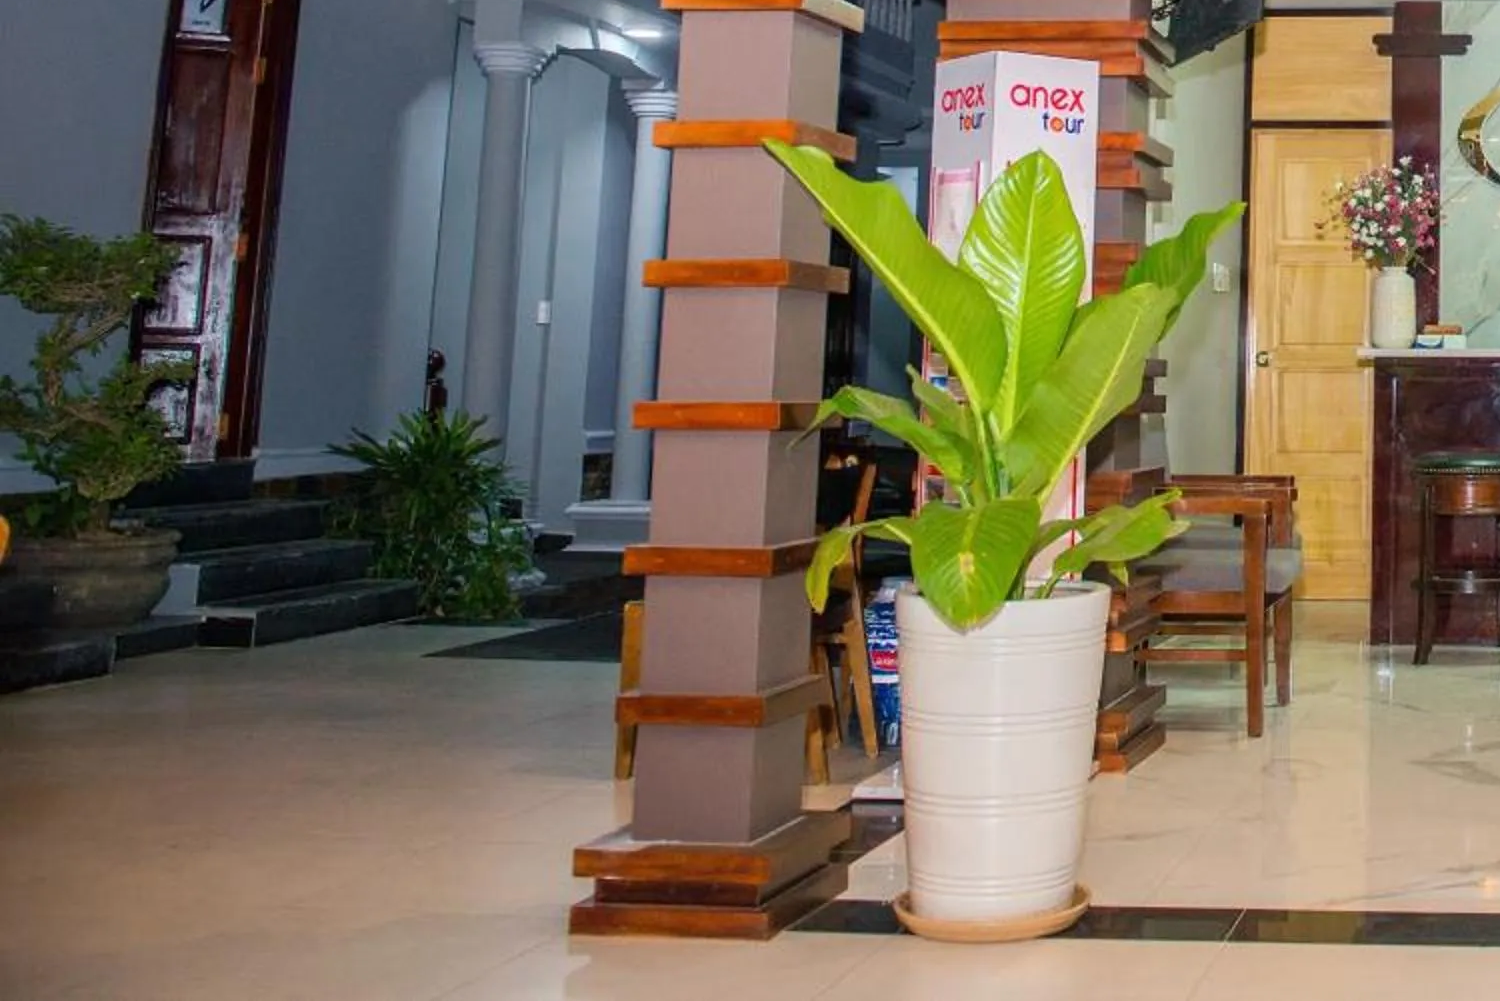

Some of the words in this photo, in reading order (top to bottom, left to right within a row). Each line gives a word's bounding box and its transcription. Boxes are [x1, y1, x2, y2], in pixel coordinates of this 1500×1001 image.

[941, 83, 985, 113] anex
[1010, 84, 1085, 114] anex
[959, 111, 985, 132] tour
[1042, 111, 1085, 134] tour
